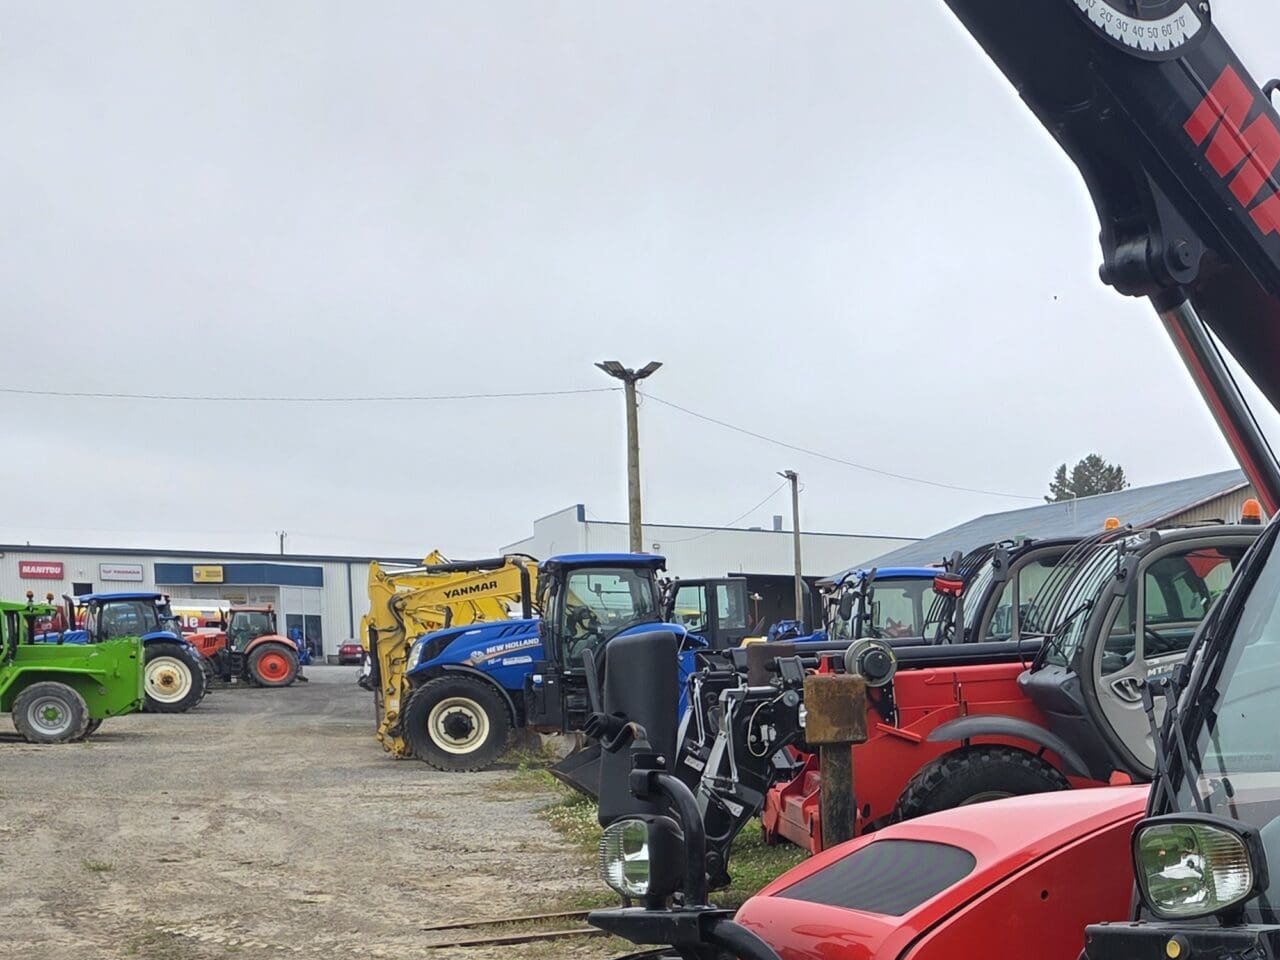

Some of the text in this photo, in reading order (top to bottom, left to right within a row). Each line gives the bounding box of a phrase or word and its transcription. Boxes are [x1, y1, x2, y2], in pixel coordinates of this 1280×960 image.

[22, 565, 61, 574] MANITOU
[443, 581, 498, 599] YANMAR
[486, 638, 540, 655] NEW HOLLAND
